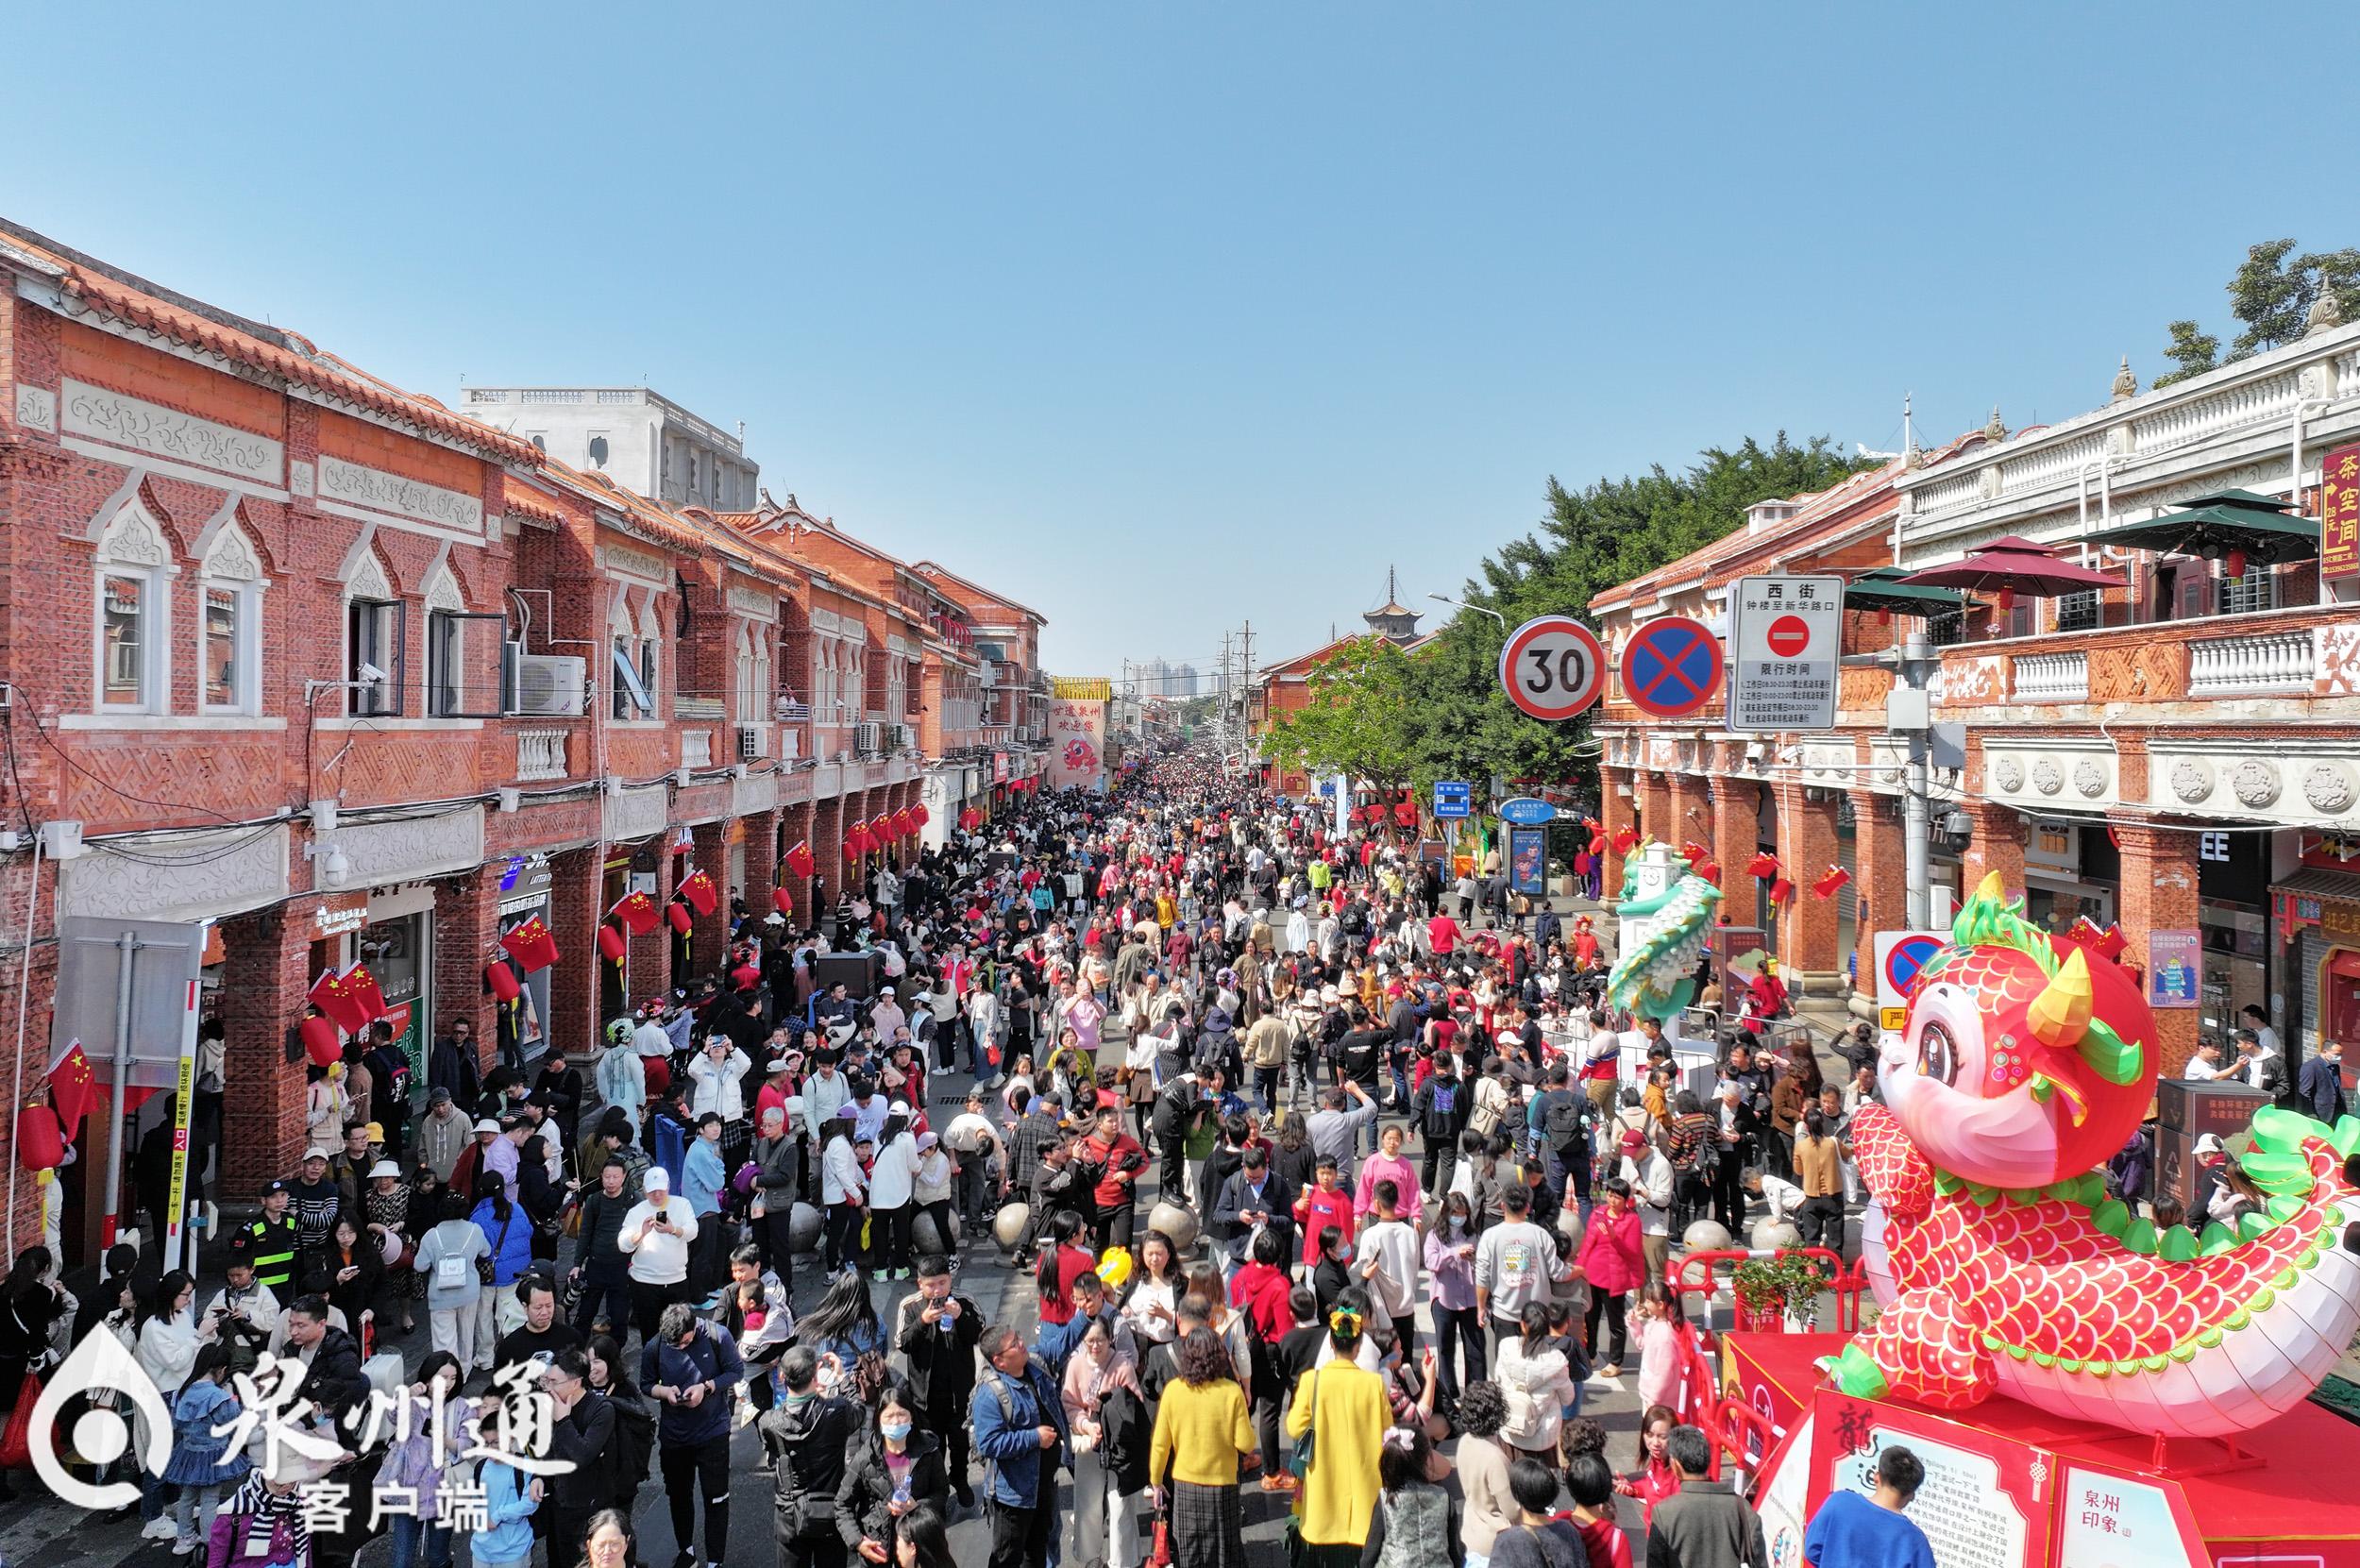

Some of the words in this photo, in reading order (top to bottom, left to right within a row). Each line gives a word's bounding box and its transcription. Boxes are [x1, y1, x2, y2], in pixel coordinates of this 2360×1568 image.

[2338, 455, 2359, 545] 茶空间
[1768, 583, 1814, 599] 西街
[1746, 600, 1834, 611] 钟楼至新华路口
[1526, 649, 1585, 693] 30
[1761, 663, 1811, 675] 限行时间
[1053, 703, 1101, 718] 世遗泉州
[1058, 720, 1094, 733] 欢迎您
[175, 1129, 186, 1150] 入口
[2084, 1490, 2120, 1512] 泉州
[2082, 1511, 2117, 1534] 印象
